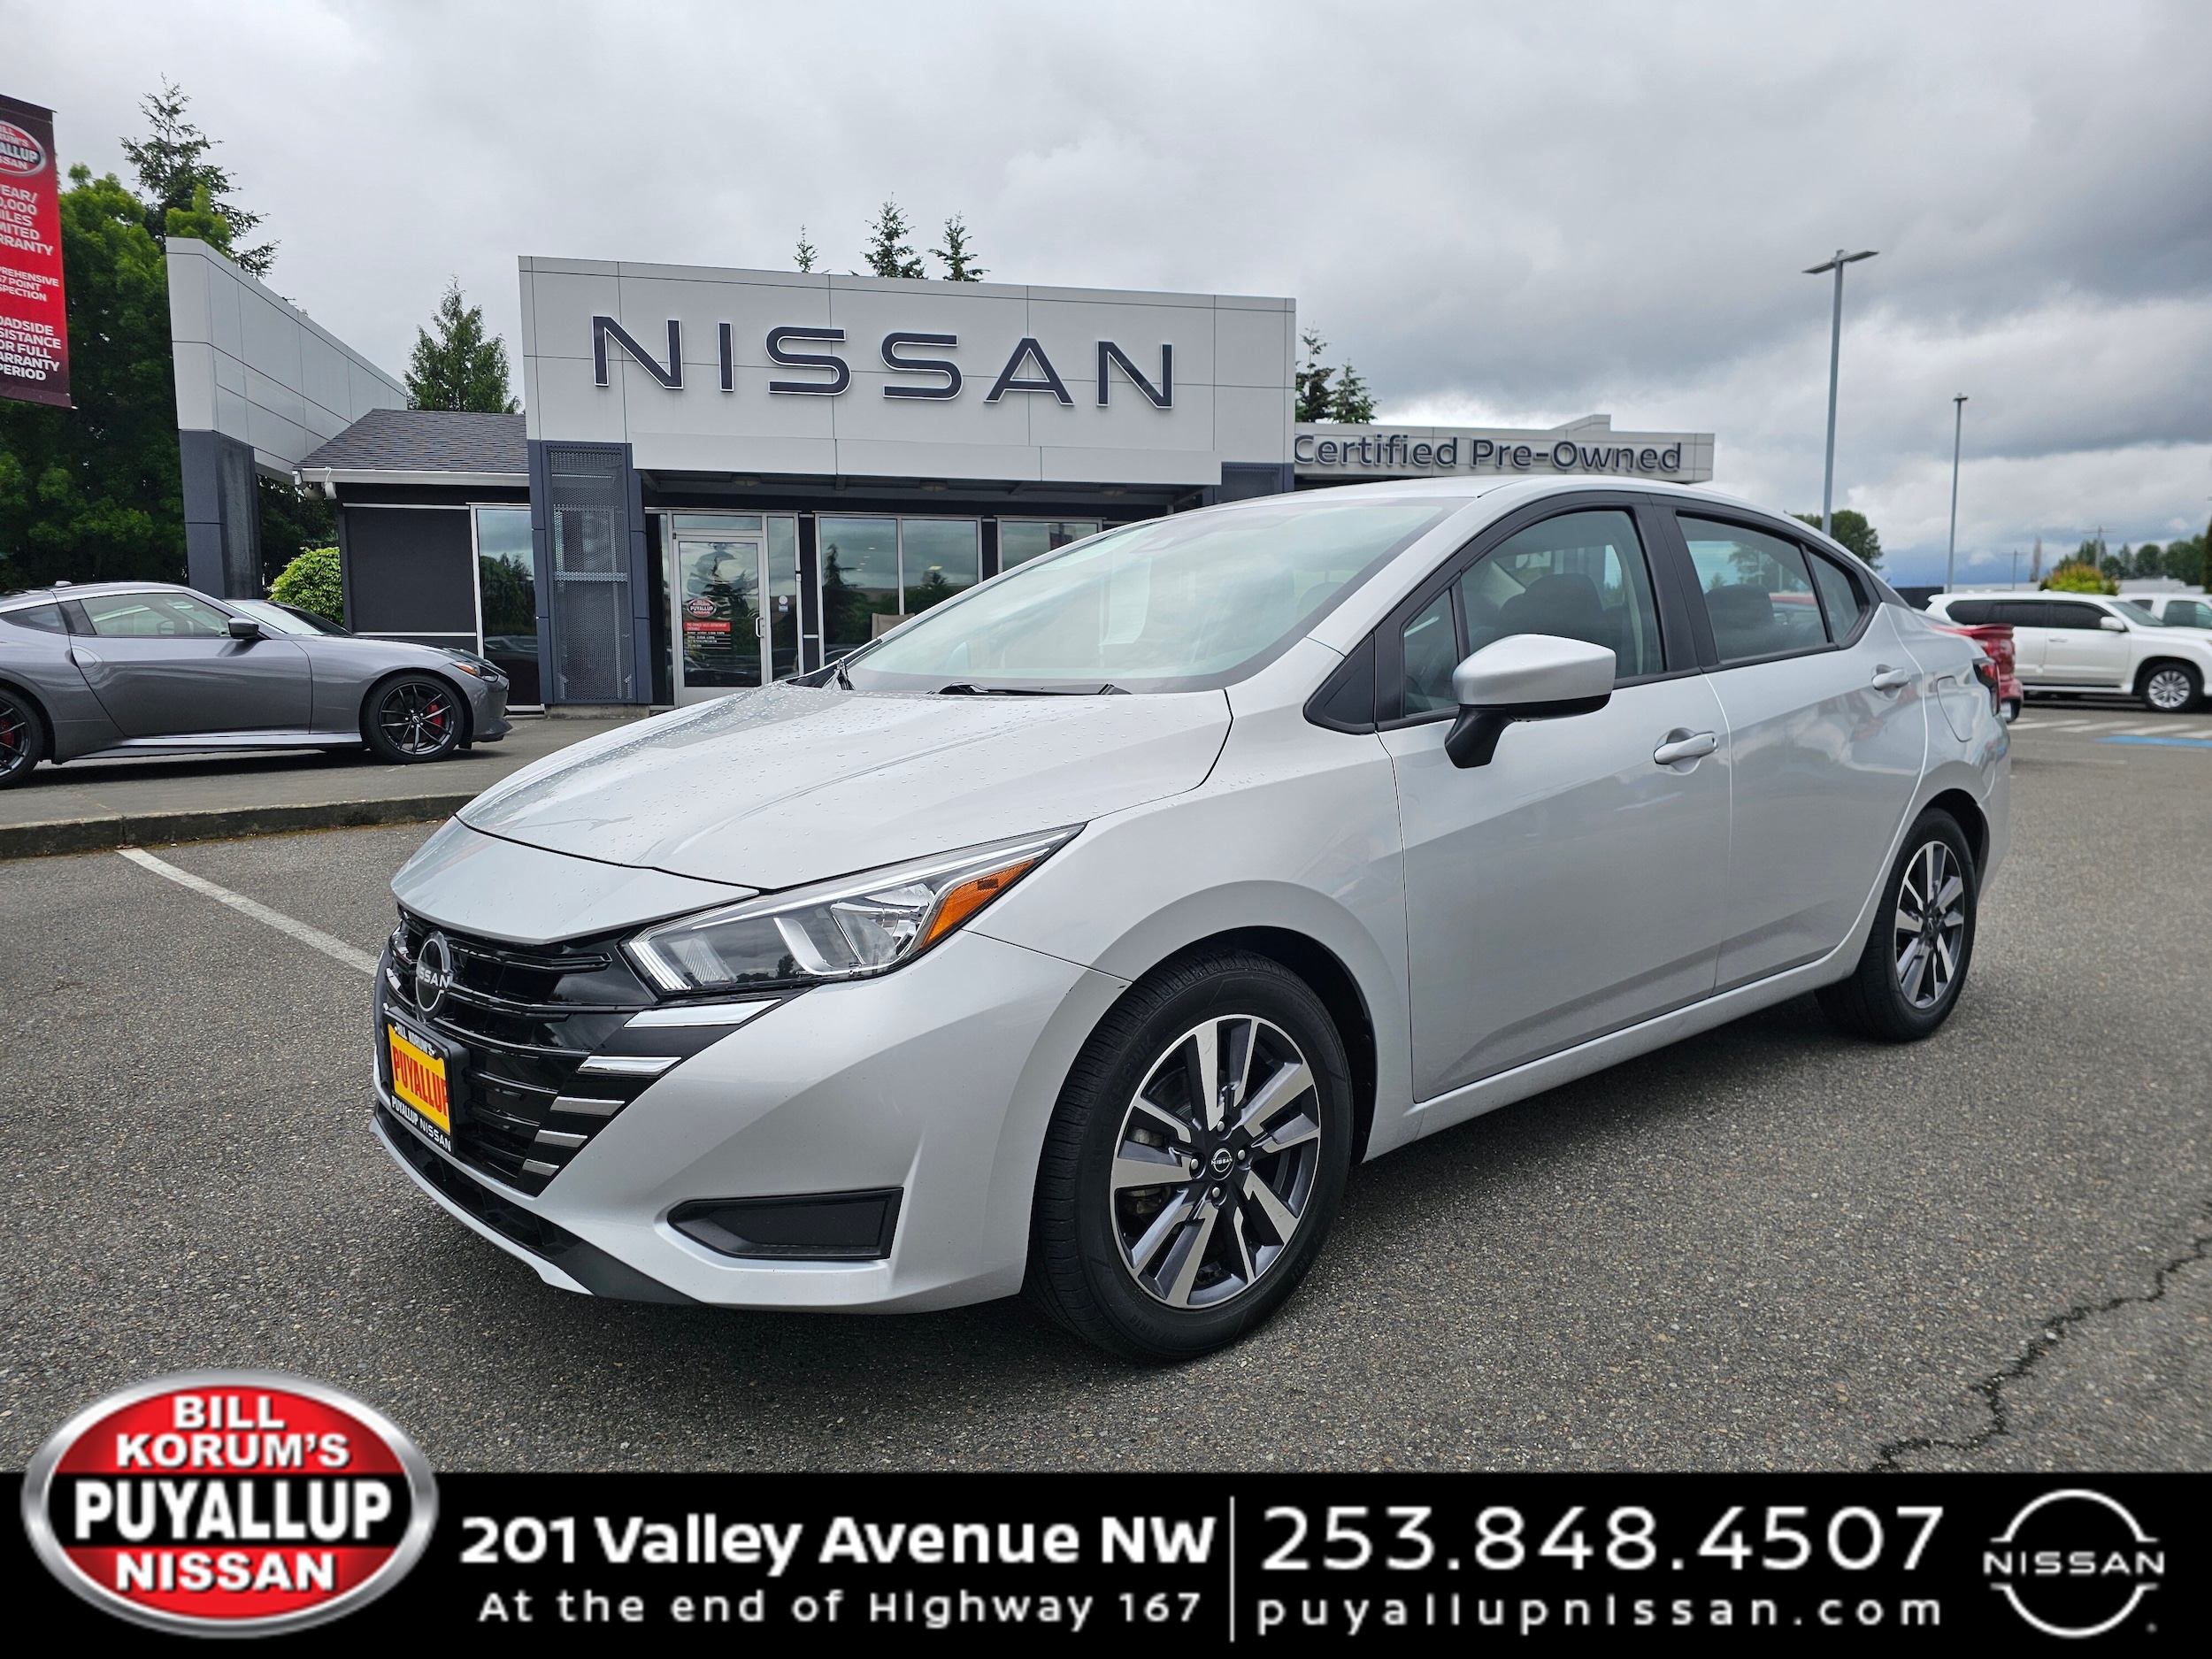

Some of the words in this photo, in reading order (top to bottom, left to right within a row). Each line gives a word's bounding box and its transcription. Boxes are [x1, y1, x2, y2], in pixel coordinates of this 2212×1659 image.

[0, 184, 37, 204] EAR/
[0, 210, 33, 227] ILES
[0, 266, 59, 287] REHENSIVE
[9, 277, 42, 291] POINT
[17, 342, 51, 359] FULL
[592, 315, 1174, 409] NISSAN
[1294, 433, 1457, 467] Certified
[1471, 440, 1682, 472] Pre-Owned
[391, 1094, 419, 1125] PUYALLUP
[419, 1118, 451, 1152] NISSAN
